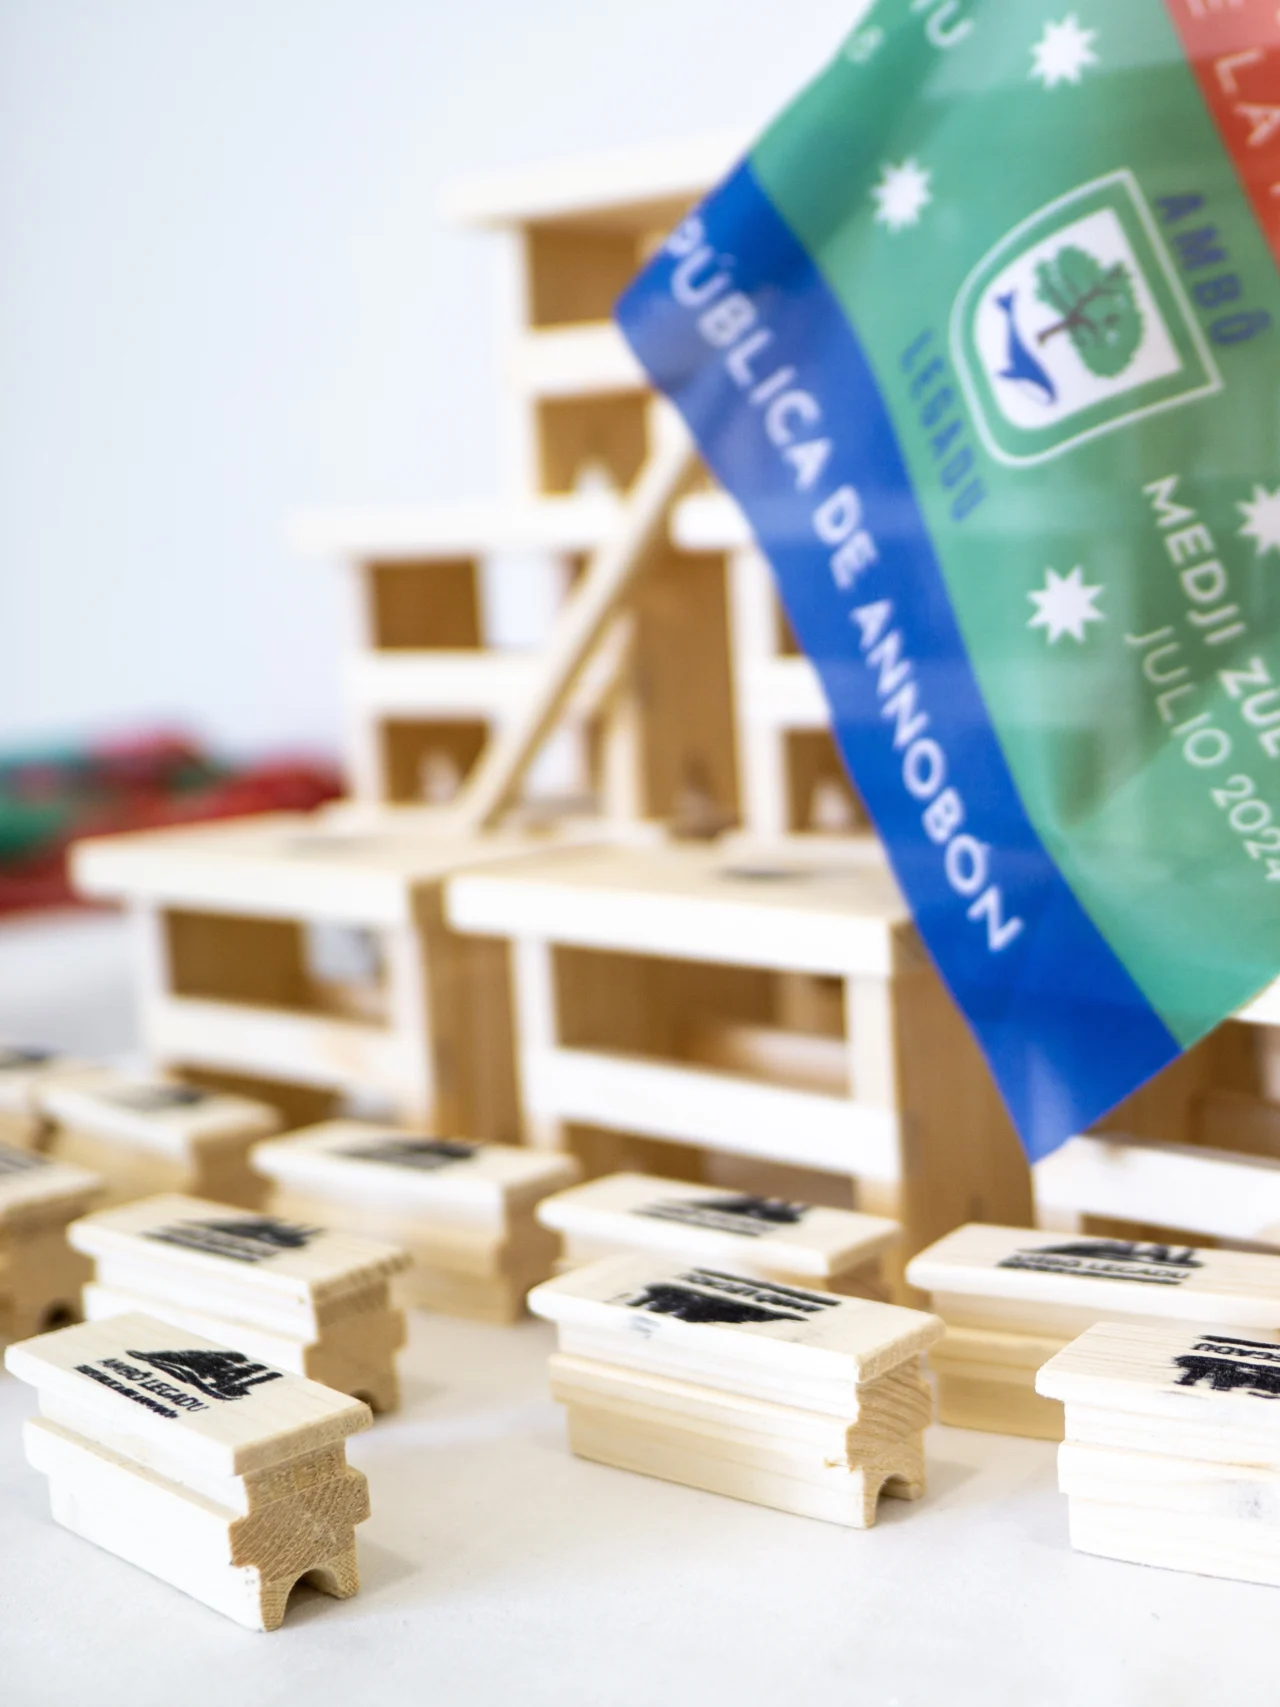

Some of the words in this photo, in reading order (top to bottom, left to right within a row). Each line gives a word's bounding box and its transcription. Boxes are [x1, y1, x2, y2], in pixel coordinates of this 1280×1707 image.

[901, 329, 988, 523] LEGADU
[1143, 474, 1246, 645] MEDJI
[812, 485, 879, 590] DE
[850, 598, 1024, 952] ANNOBÓN
[1124, 625, 1232, 767] JULIO
